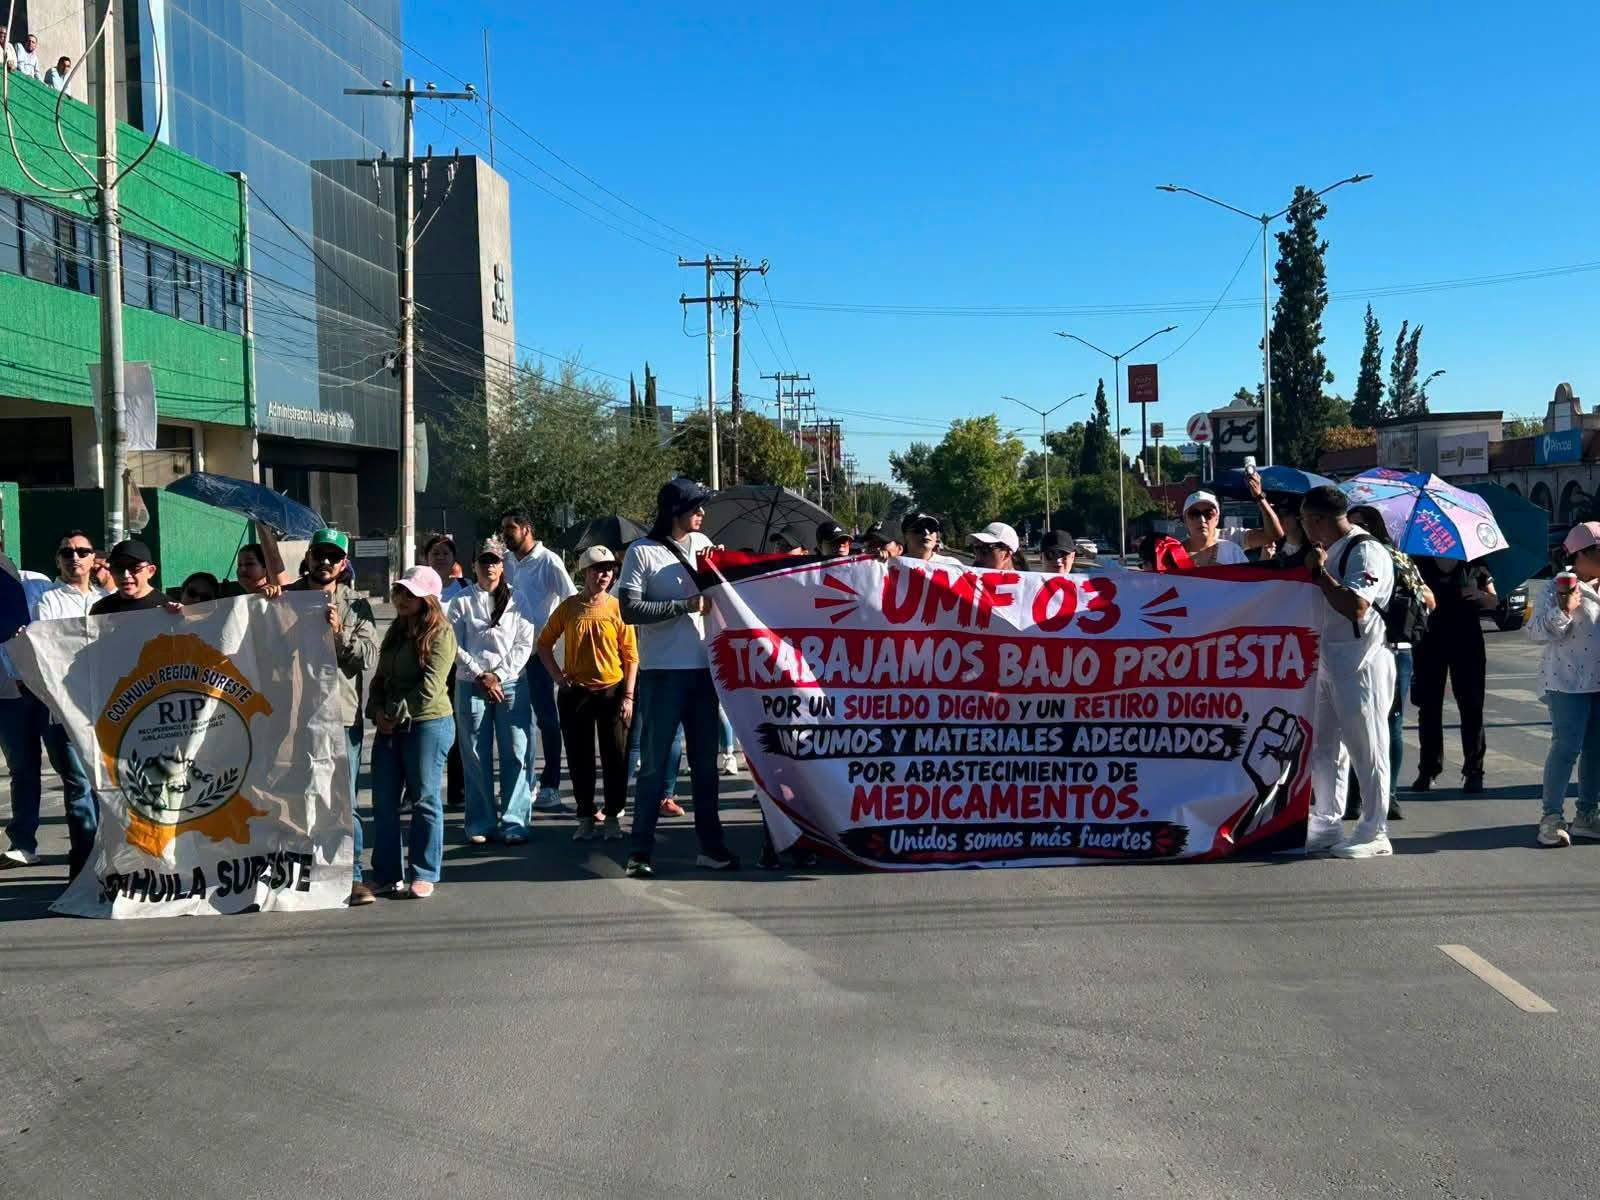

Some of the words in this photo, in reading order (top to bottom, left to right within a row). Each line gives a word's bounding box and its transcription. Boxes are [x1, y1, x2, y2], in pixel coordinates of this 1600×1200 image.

[881, 566, 1021, 629] UMF
[1032, 576, 1121, 635] 03
[727, 634, 984, 685] TRABAJAMOS
[998, 642, 1100, 688] BAJO
[1113, 632, 1305, 687] PROTESTA
[108, 676, 157, 722] COAHUILA
[159, 664, 198, 683] REGION
[202, 668, 253, 704] SURESTE
[763, 694, 801, 718] POR
[809, 694, 835, 719] UN
[843, 693, 930, 720] SUELDO
[937, 693, 1010, 722] DIGNO
[1036, 698, 1065, 718] UN
[1073, 692, 1158, 720] RETIRO
[1166, 691, 1250, 724] DIGNO,
[159, 698, 205, 724] RJP
[777, 726, 883, 755] INSUMOS
[891, 727, 906, 753] Y
[915, 727, 1064, 753] MATERIALES
[1072, 727, 1233, 757] ADECUADOS,
[848, 760, 896, 783] POR
[904, 760, 1098, 783] ABASTECIMIENTO
[1107, 761, 1138, 784] DE
[850, 783, 1150, 822] MEDICAMENTOS.
[890, 826, 958, 852] Unidos
[965, 831, 1024, 851] somos
[1030, 825, 1071, 849] más
[1078, 824, 1152, 851] fuertes
